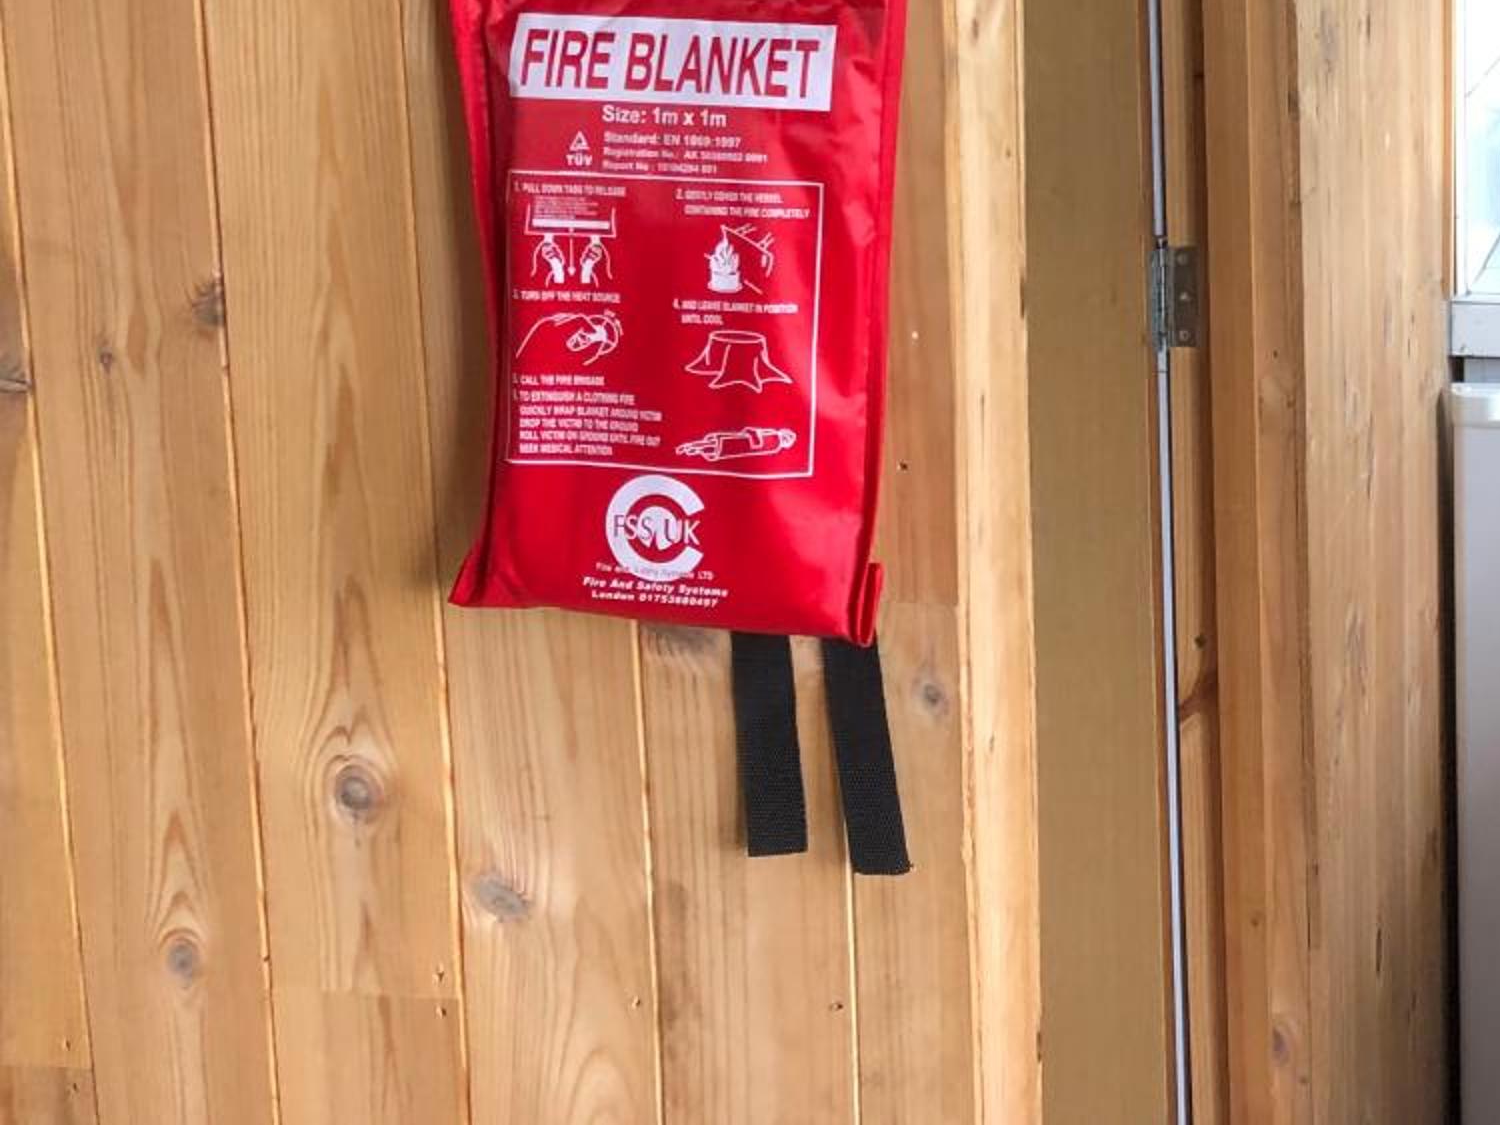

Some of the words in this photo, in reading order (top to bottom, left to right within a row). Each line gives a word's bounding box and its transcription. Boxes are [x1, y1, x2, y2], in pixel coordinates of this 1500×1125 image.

[520, 28, 616, 90] FIRE
[624, 32, 821, 99] BLANKET
[602, 104, 647, 124] Size:
[652, 107, 678, 125] 1m
[683, 112, 694, 125] x
[700, 110, 727, 127] 1m
[566, 154, 592, 166] TÜV
[613, 514, 655, 540] FSS
[665, 519, 701, 546] UK
[583, 576, 607, 588] Fire
[610, 578, 633, 590] And
[636, 580, 675, 594] Safety
[679, 584, 729, 598] Systems
[591, 590, 635, 601] London
